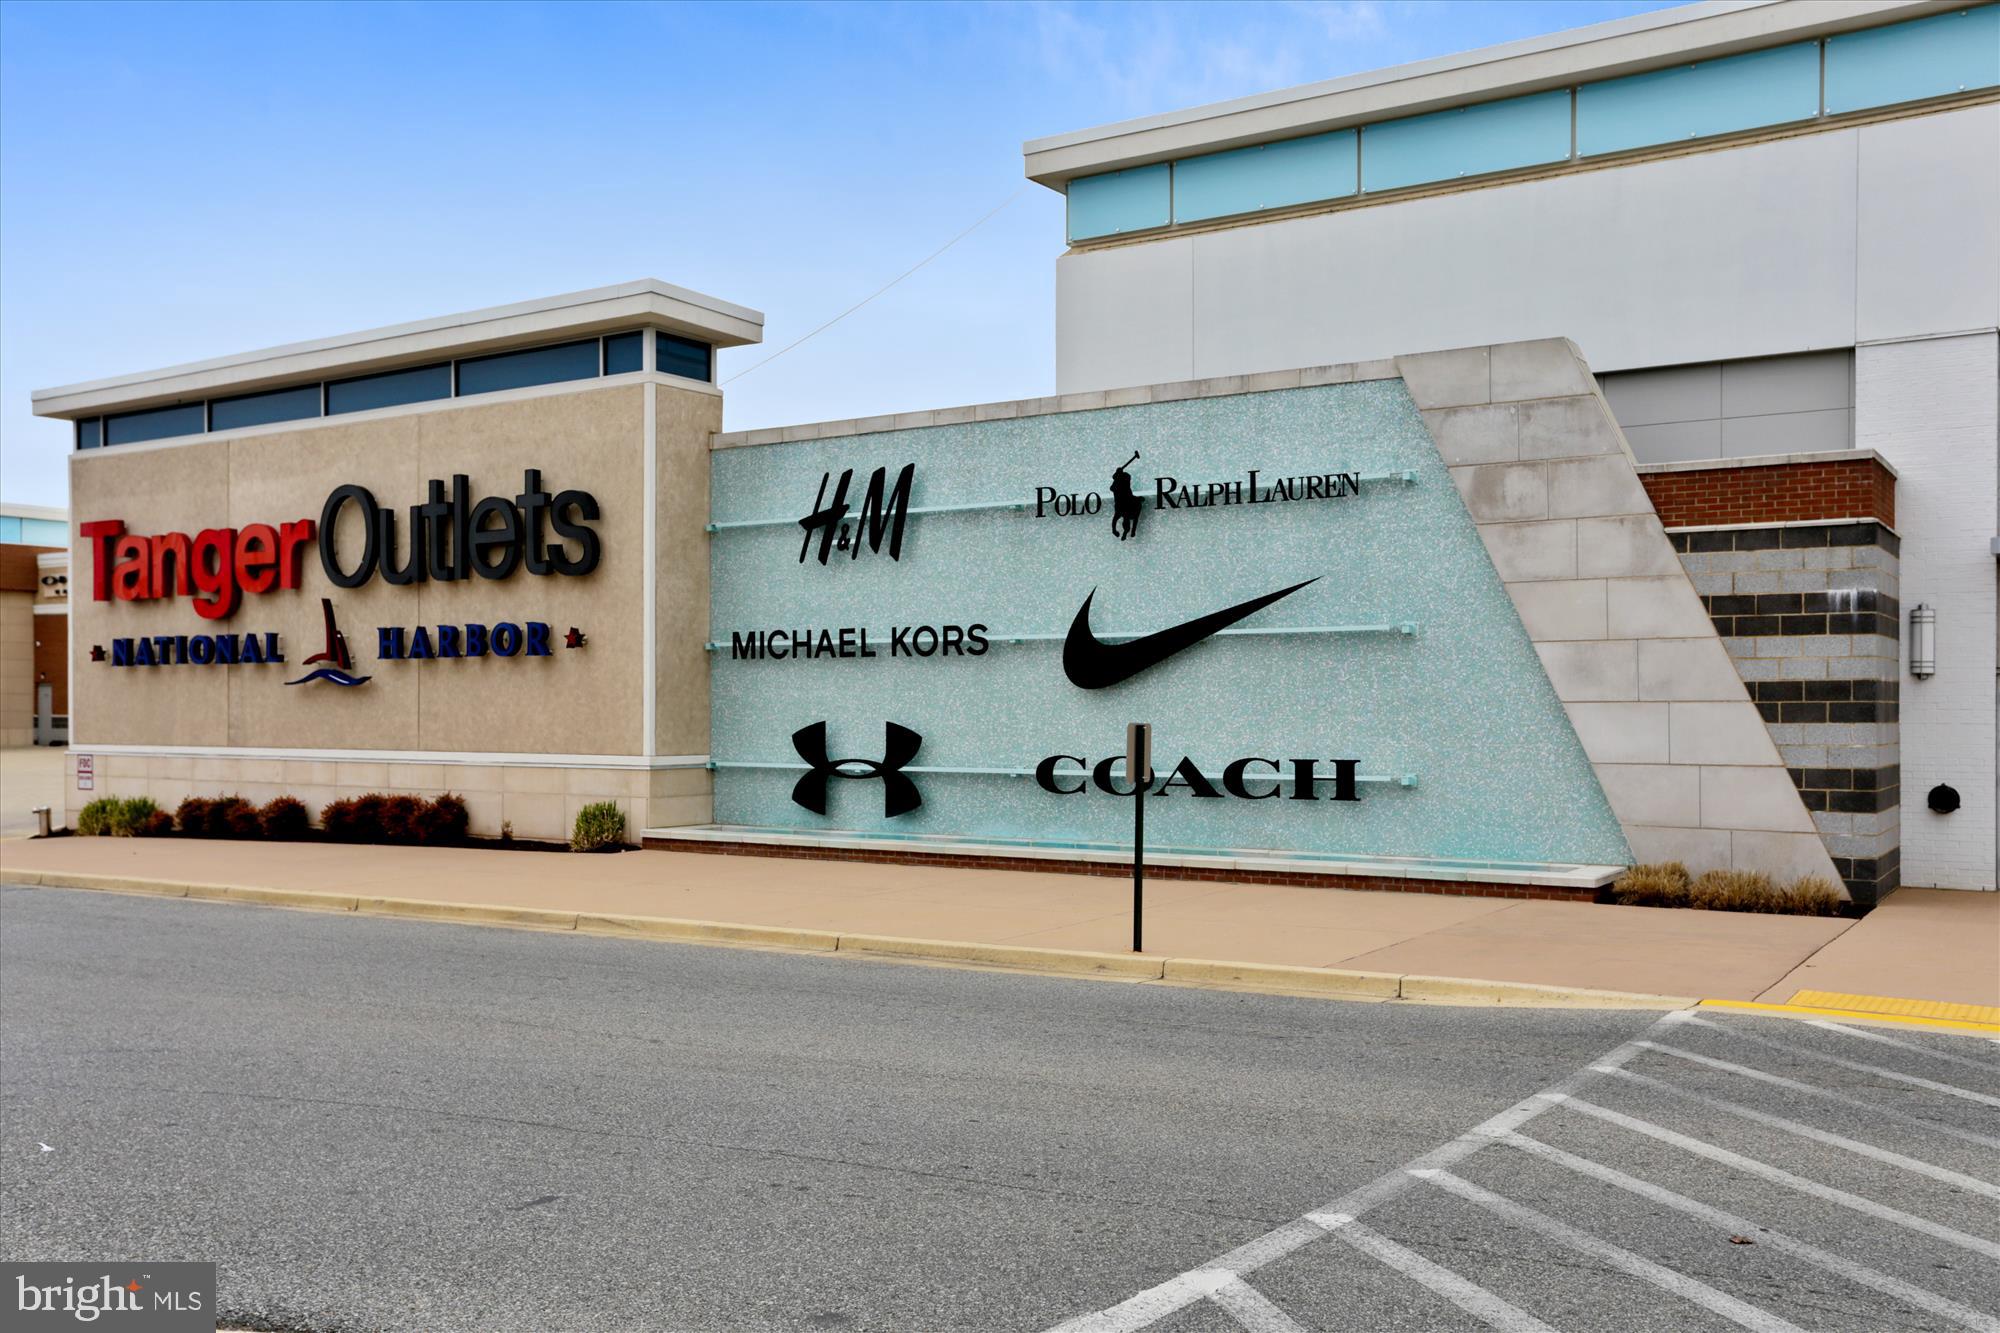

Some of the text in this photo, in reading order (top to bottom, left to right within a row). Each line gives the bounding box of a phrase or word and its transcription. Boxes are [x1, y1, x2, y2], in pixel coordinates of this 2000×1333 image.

[798, 462, 915, 566] H&M
[81, 468, 600, 620] Tanger Outlets
[111, 621, 553, 667] NATIONAL HARBOR
[732, 623, 989, 660] MICHAEL KORS
[1035, 754, 1361, 802] COACH
